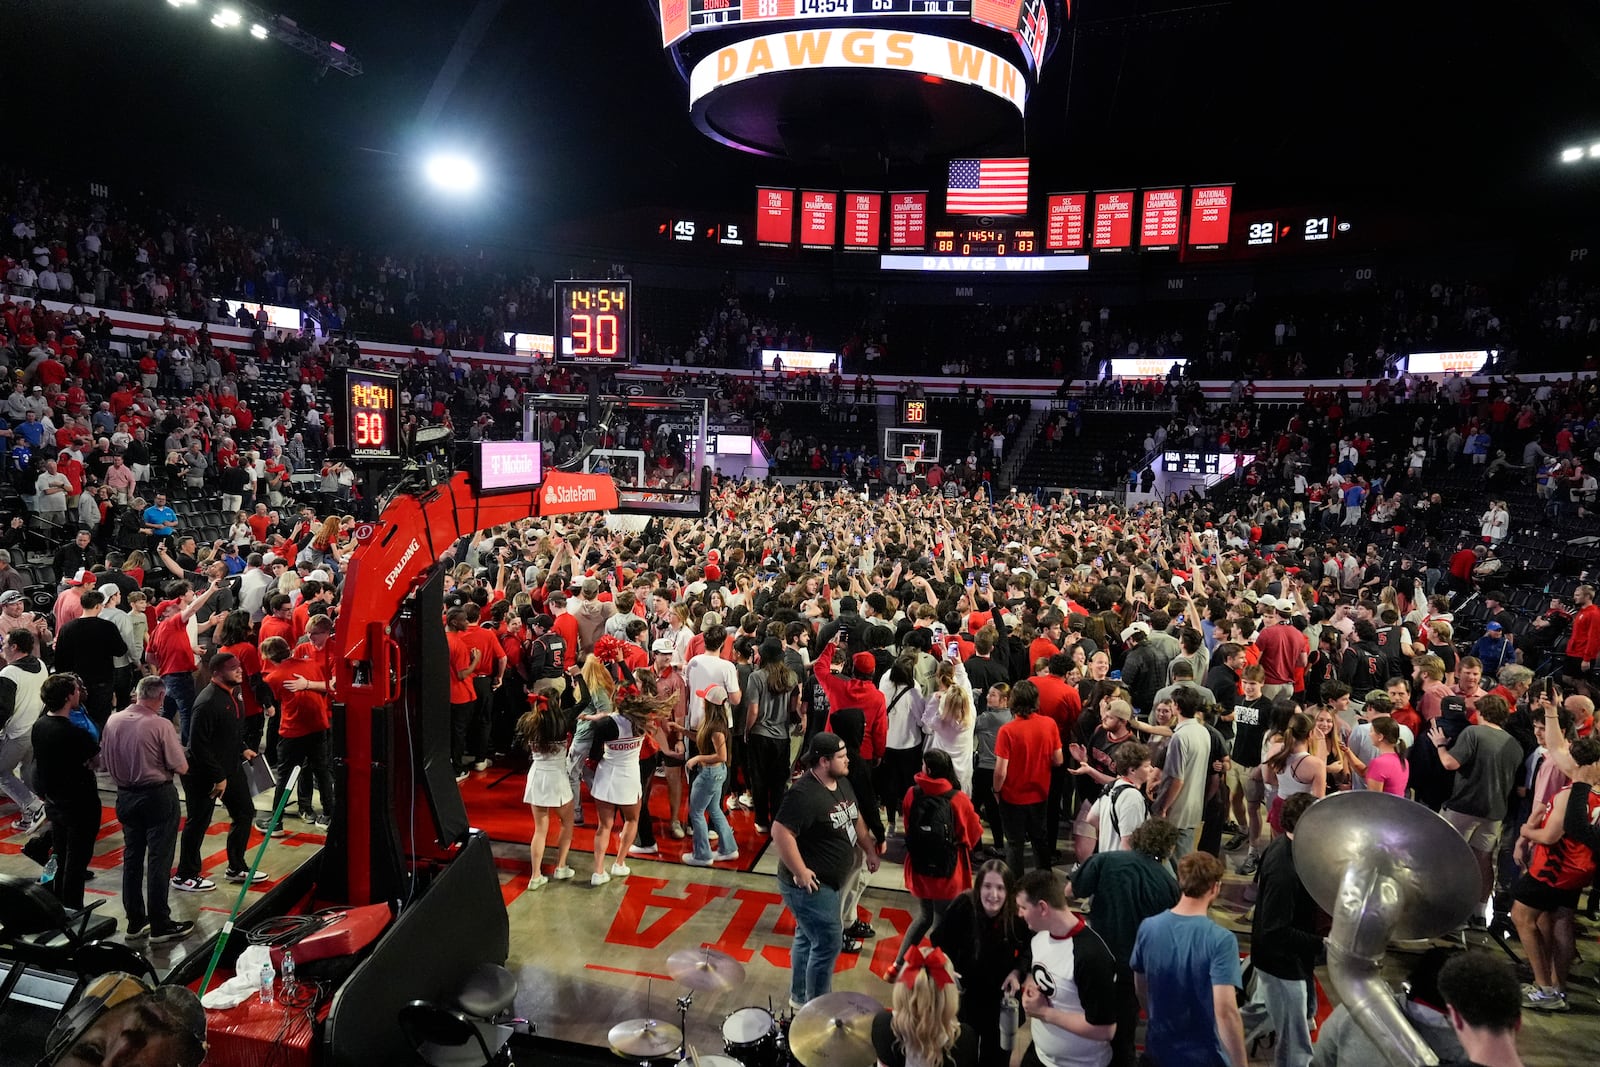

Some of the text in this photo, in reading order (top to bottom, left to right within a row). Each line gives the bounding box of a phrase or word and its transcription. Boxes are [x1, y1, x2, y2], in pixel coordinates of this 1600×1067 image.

[717, 30, 1018, 100] DAWGS WIN
[90, 183, 108, 198] HH
[1199, 190, 1225, 198] NATIONAL
[768, 192, 782, 200] FINAL
[815, 195, 824, 203] SEC
[857, 196, 870, 204] FINAL
[904, 196, 913, 204] SEC
[1109, 195, 1119, 203] SEC
[1150, 192, 1175, 200] NATIONAL
[804, 201, 833, 209] CHAMPIONS
[1098, 202, 1129, 211] CHAMPIONS
[1147, 199, 1178, 208] CHAMPIONS
[1195, 197, 1227, 206] CHAMPIONS
[894, 203, 922, 211] CHAMPIONS
[1052, 205, 1081, 213] CHAMPIONS
[674, 220, 696, 235] 45
[1249, 222, 1274, 238] 32
[1305, 217, 1329, 234] 21
[727, 225, 738, 239] 5
[968, 230, 995, 241] 14:54
[939, 240, 953, 251] 88
[963, 244, 970, 255] 0
[998, 244, 1005, 255] 0
[1018, 240, 1033, 251] 83
[923, 257, 1046, 270] DAWGS WIN
[1168, 279, 1184, 289] NN
[955, 287, 973, 297] MM
[572, 289, 624, 311] 14:54
[571, 314, 617, 354] 30
[1439, 352, 1478, 361] DAWGS
[789, 358, 813, 367] WIN
[1442, 361, 1474, 371] WIN
[1138, 366, 1164, 375] WIN
[908, 409, 922, 421] 30
[356, 412, 382, 444] 30
[355, 448, 391, 456] DAKTRONICS
[1165, 452, 1180, 461] UGA
[1205, 454, 1218, 463] UF
[503, 454, 533, 474] Mobile
[385, 537, 420, 590] SPALDING
[1377, 632, 1388, 646] 5
[553, 650, 562, 668] 5
[1368, 657, 1377, 674] 5
[609, 741, 640, 751] GEORGIA
